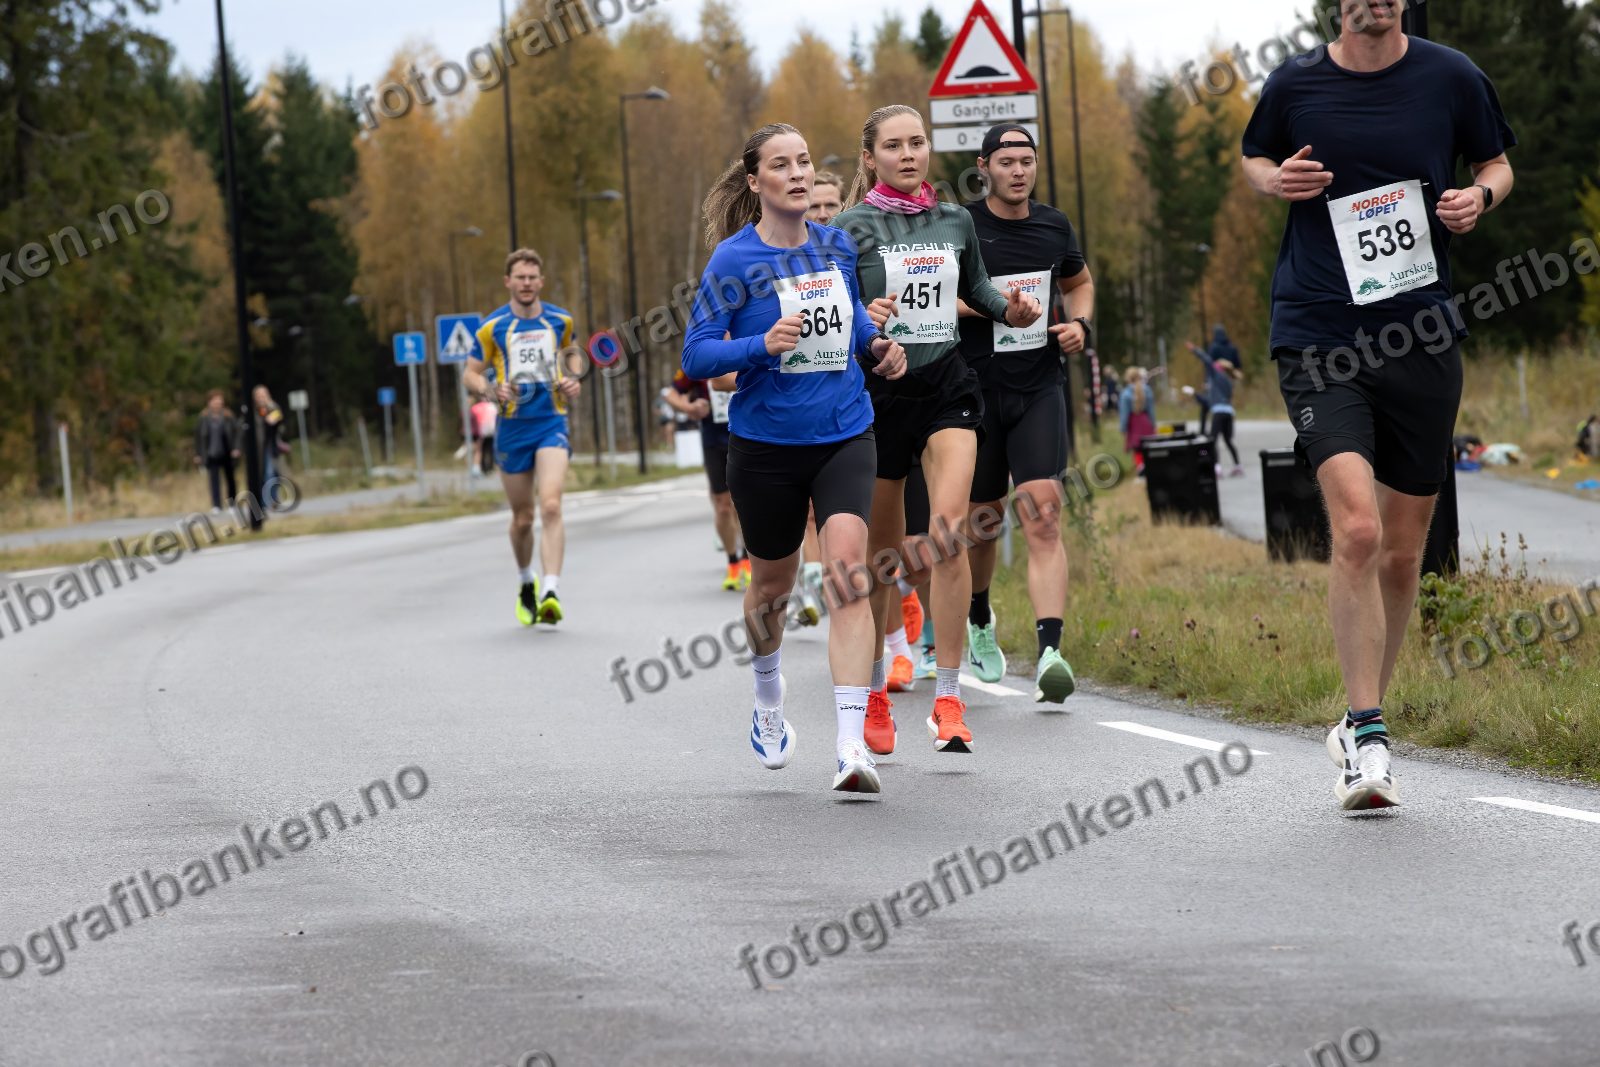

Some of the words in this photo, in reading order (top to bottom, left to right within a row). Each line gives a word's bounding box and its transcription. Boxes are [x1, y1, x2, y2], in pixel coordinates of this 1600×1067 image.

[952, 102, 1016, 118] Gangfelt
[957, 132, 968, 145] 0
[1350, 188, 1405, 213] NORGES
[1359, 201, 1399, 221] LØPET
[1357, 218, 1416, 262] 538
[902, 256, 945, 266] NORGES
[907, 265, 939, 275] LØPET
[1388, 261, 1434, 283] Aurskog
[794, 279, 833, 293] NORGES
[1007, 278, 1042, 288] NORGES
[1011, 285, 1036, 293] PET
[800, 288, 830, 301] LØPET
[900, 281, 942, 310] 451
[800, 304, 843, 339] 664
[917, 320, 954, 333] Aurskog
[519, 348, 544, 363] 561
